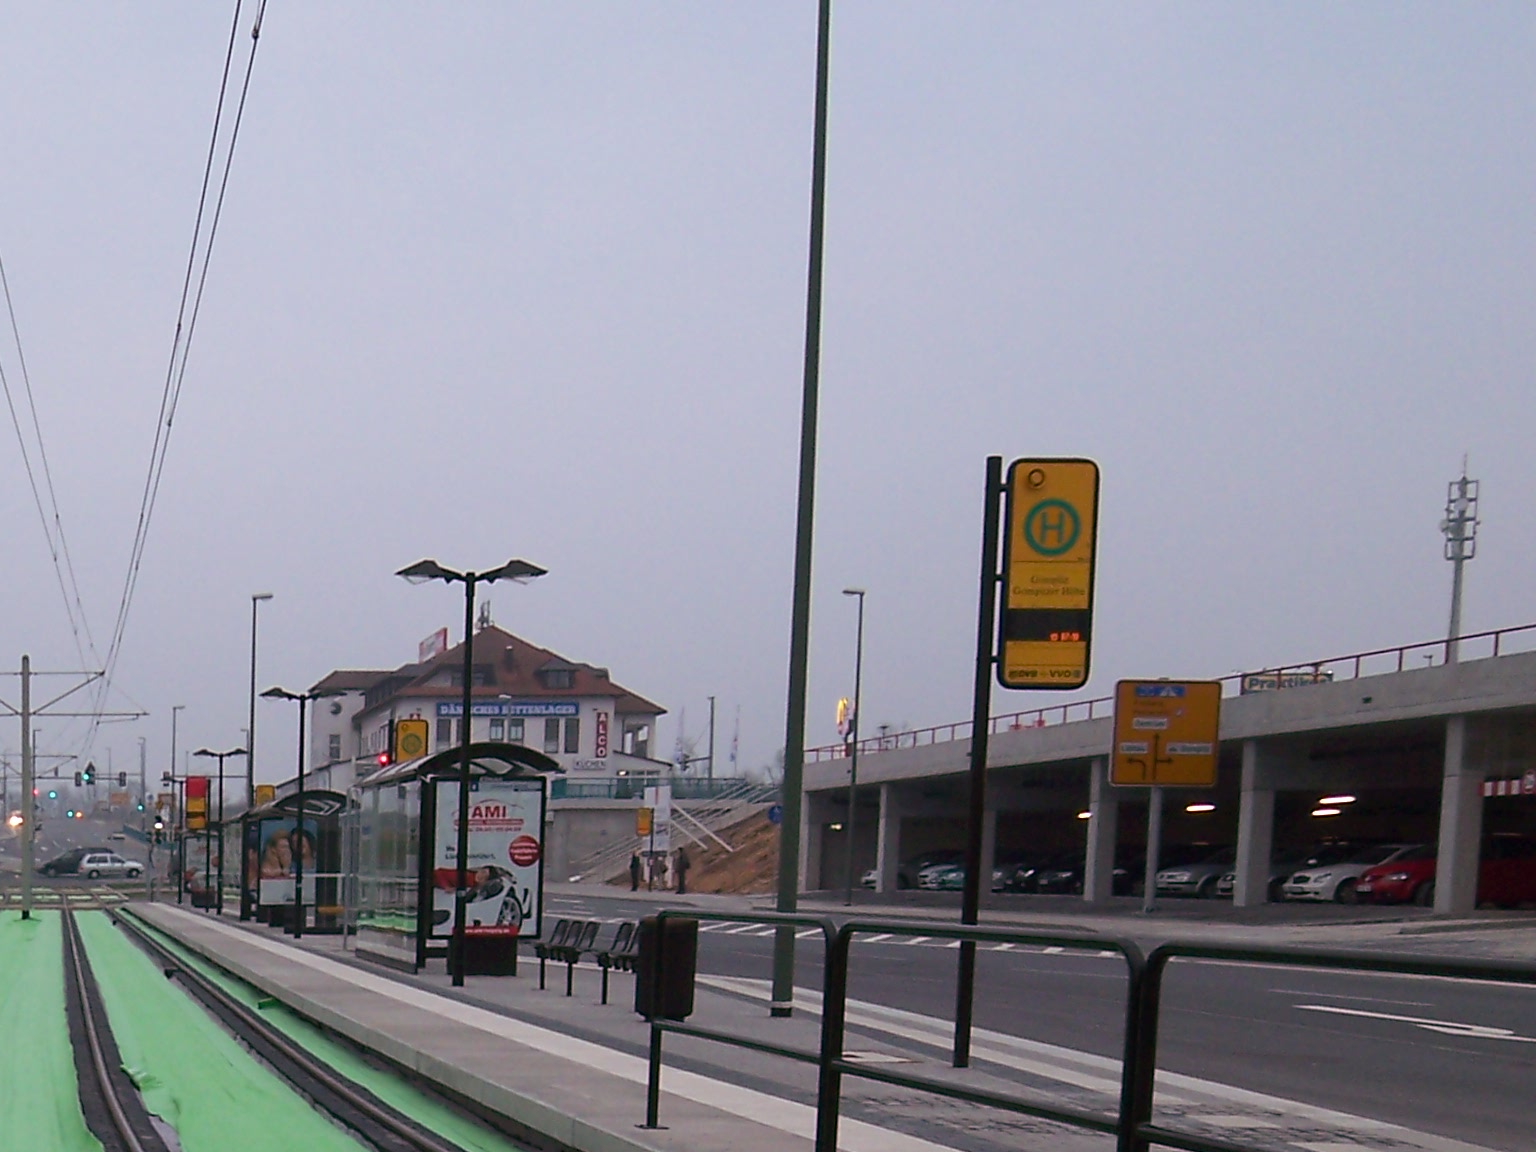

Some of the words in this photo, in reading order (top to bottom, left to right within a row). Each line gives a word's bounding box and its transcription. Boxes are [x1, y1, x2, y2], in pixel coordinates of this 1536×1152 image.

[1049, 669, 1072, 678] VVO
[597, 712, 606, 757] ALCO
[472, 805, 507, 818] AMI
